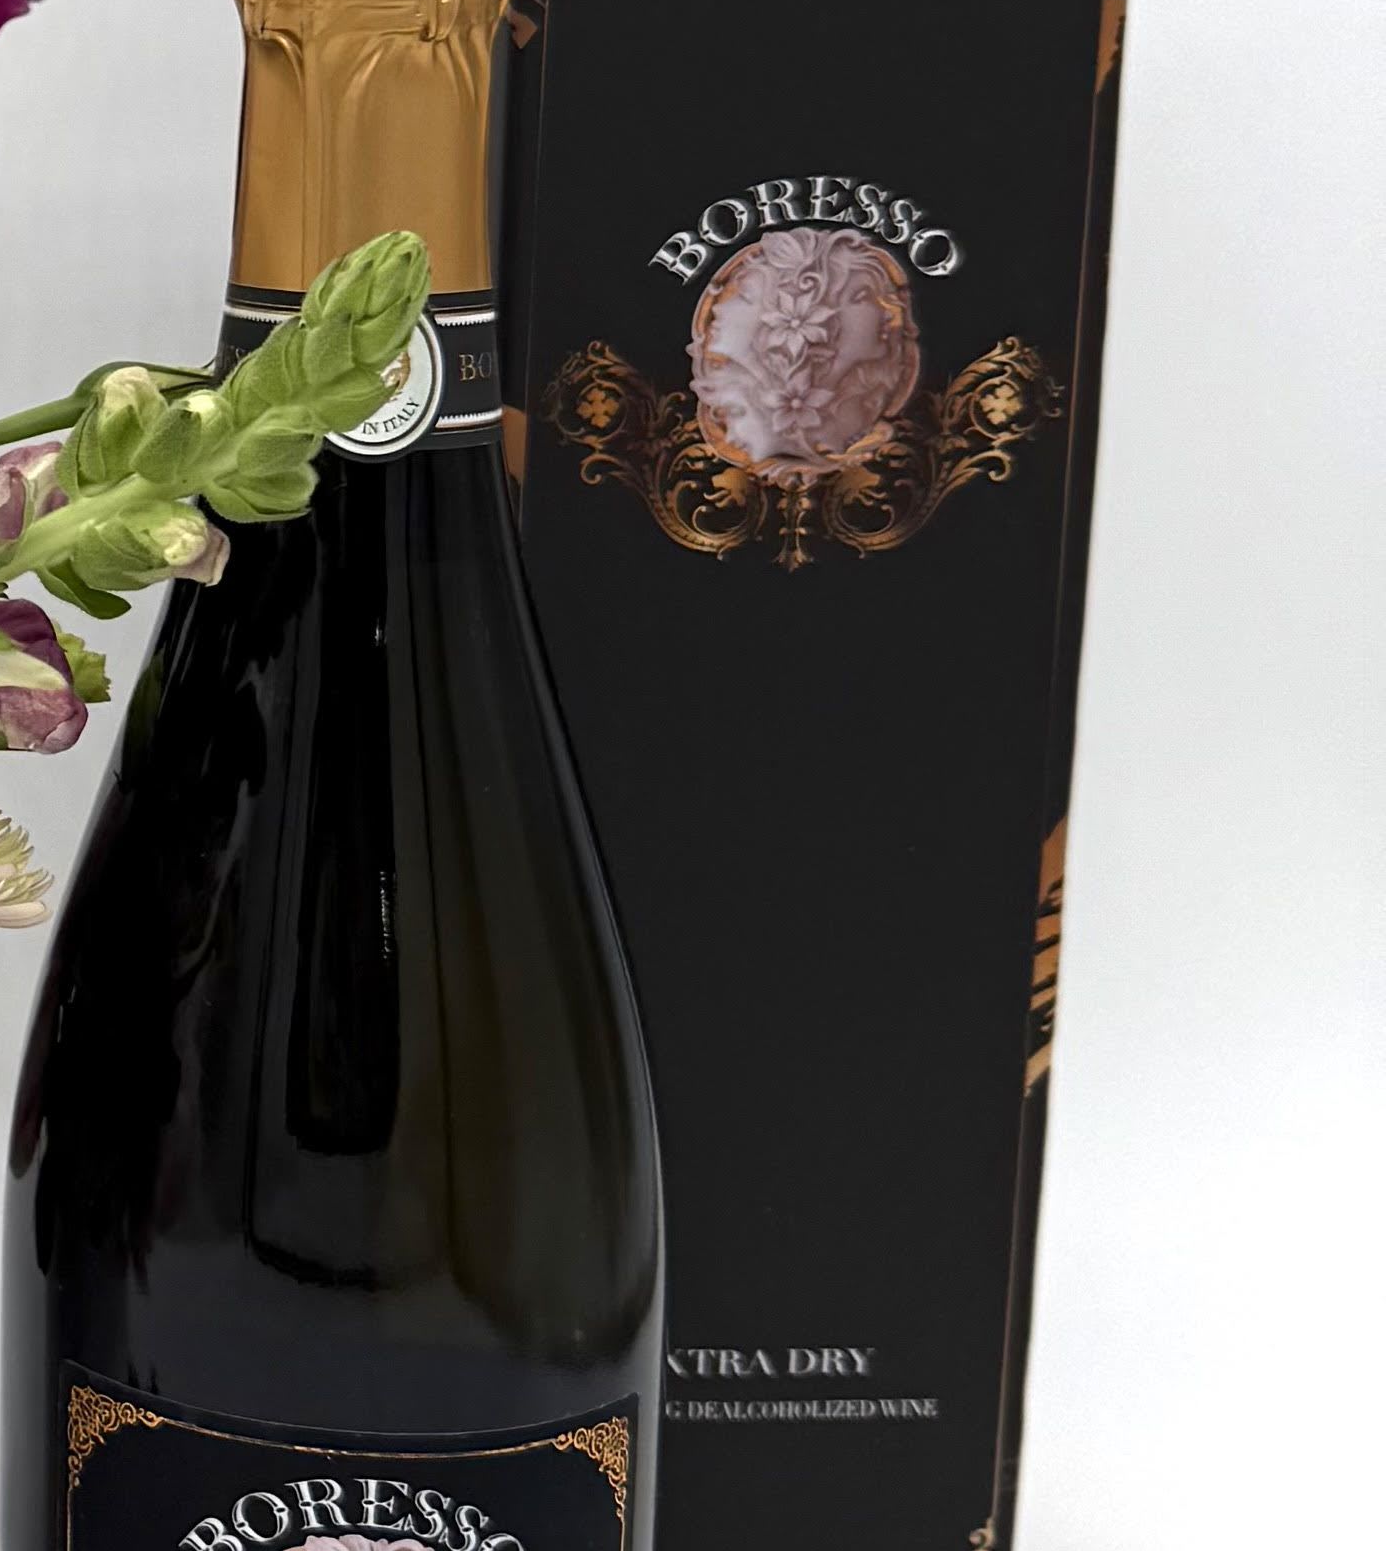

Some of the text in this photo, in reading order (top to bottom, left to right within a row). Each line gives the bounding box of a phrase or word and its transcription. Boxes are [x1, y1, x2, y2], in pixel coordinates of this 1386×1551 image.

[648, 175, 960, 285] BORESSO
[362, 399, 420, 435] IN ITALY
[667, 1348, 875, 1377] XTRA DRY
[688, 1400, 876, 1420] DEALCOHOLIZED
[879, 1399, 938, 1418] WINE
